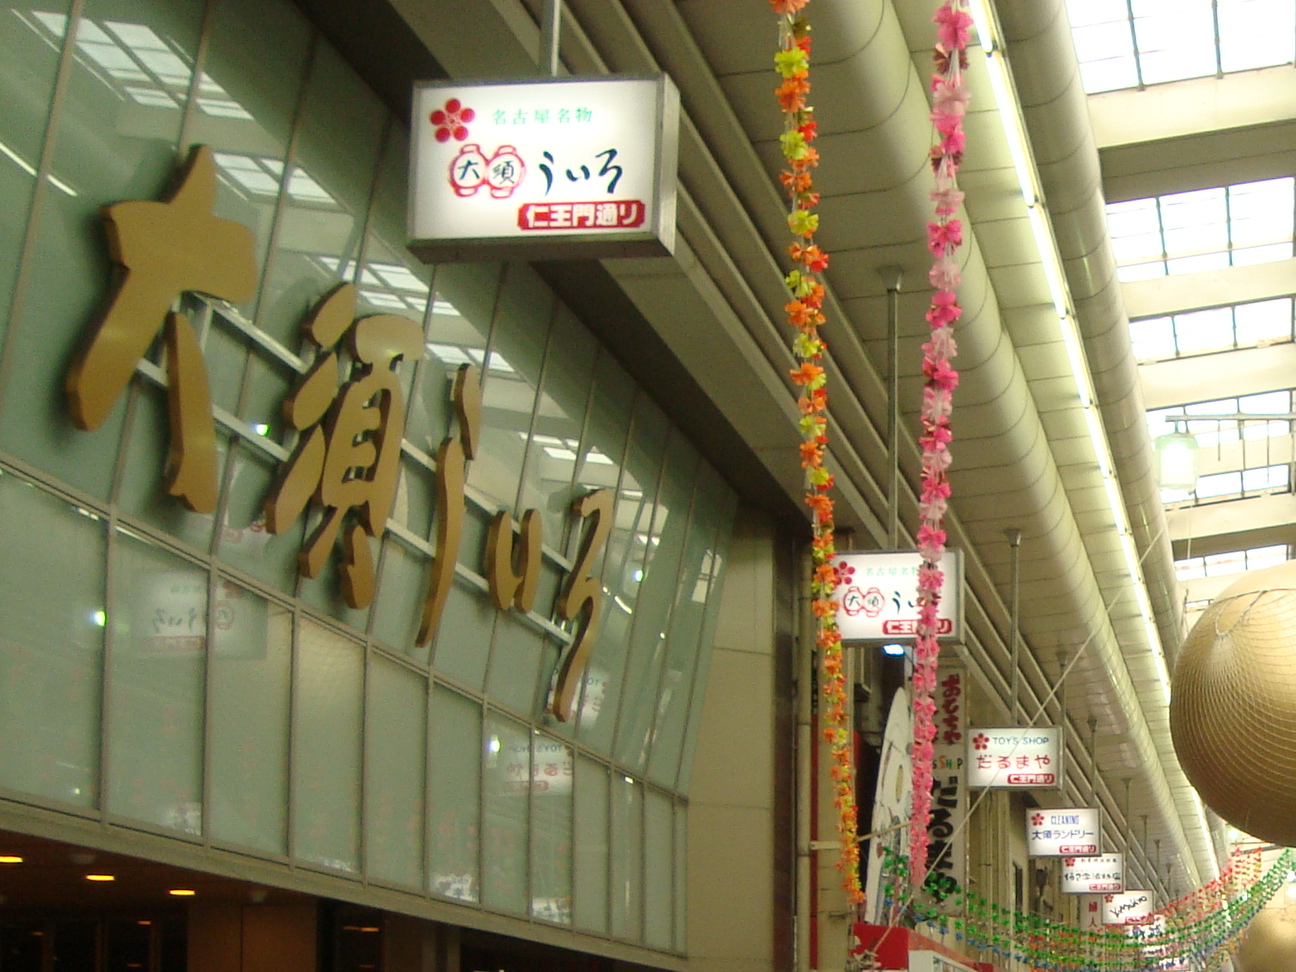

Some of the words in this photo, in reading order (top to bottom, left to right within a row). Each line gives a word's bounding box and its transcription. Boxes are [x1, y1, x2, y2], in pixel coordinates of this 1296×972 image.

[491, 106, 593, 126] 名古屋名物
[457, 160, 516, 185] 大須
[538, 148, 623, 196] ういろ
[526, 203, 639, 228] 仁王門通り
[1022, 736, 1049, 745] SHOP
[976, 754, 1051, 769] だるまや
[1031, 830, 1095, 841] 大須ランドリー
